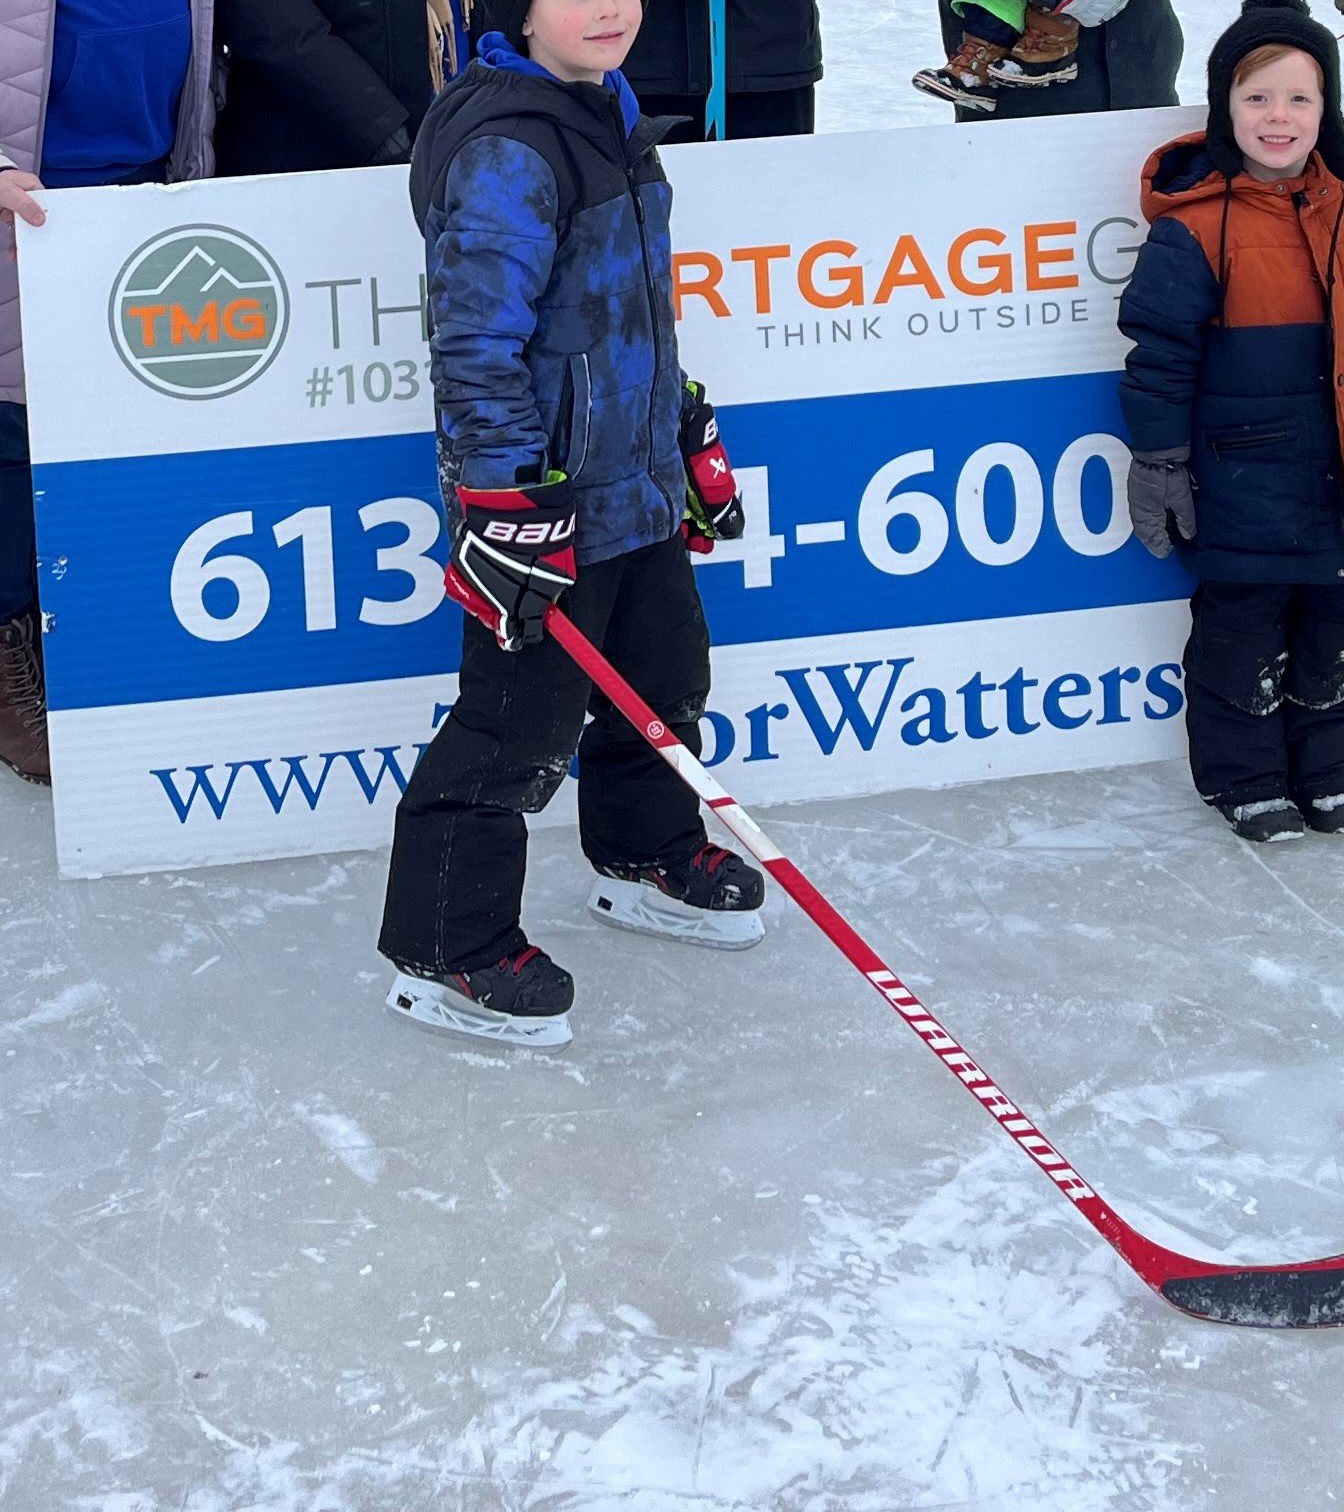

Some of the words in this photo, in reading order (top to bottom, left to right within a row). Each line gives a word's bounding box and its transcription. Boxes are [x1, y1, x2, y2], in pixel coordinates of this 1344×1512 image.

[127, 297, 267, 348] TMG
[757, 315, 883, 349] THINK
[907, 298, 1090, 336] OUTSIDE
[305, 359, 433, 408] #103
[865, 970, 1096, 1202] WARRIOR
